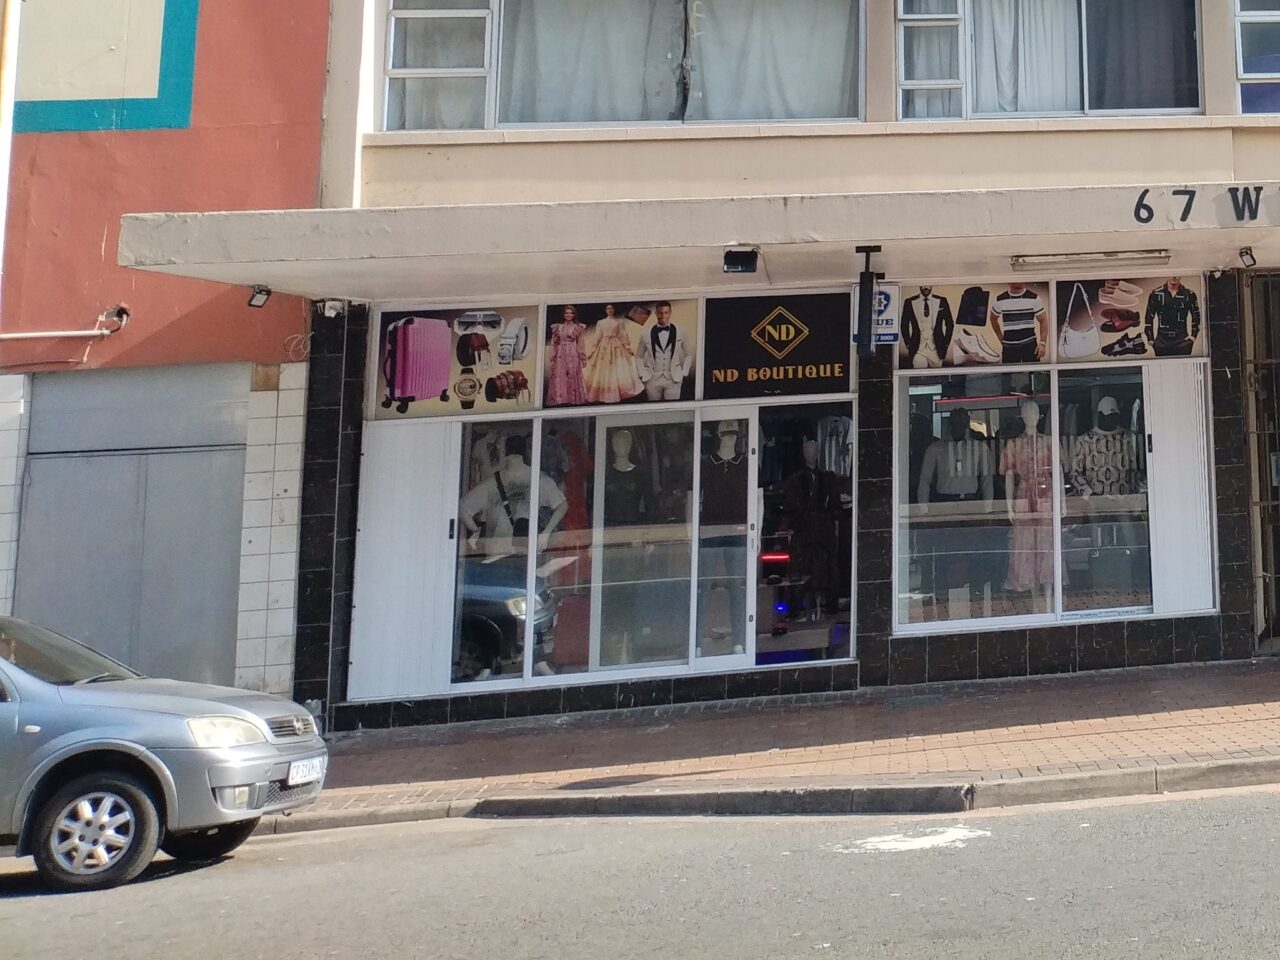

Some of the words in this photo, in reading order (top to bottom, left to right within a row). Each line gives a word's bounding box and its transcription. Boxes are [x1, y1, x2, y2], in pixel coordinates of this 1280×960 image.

[764, 325, 796, 341] ND
[712, 368, 740, 384] ND
[747, 363, 844, 382] BOUTIQUE
